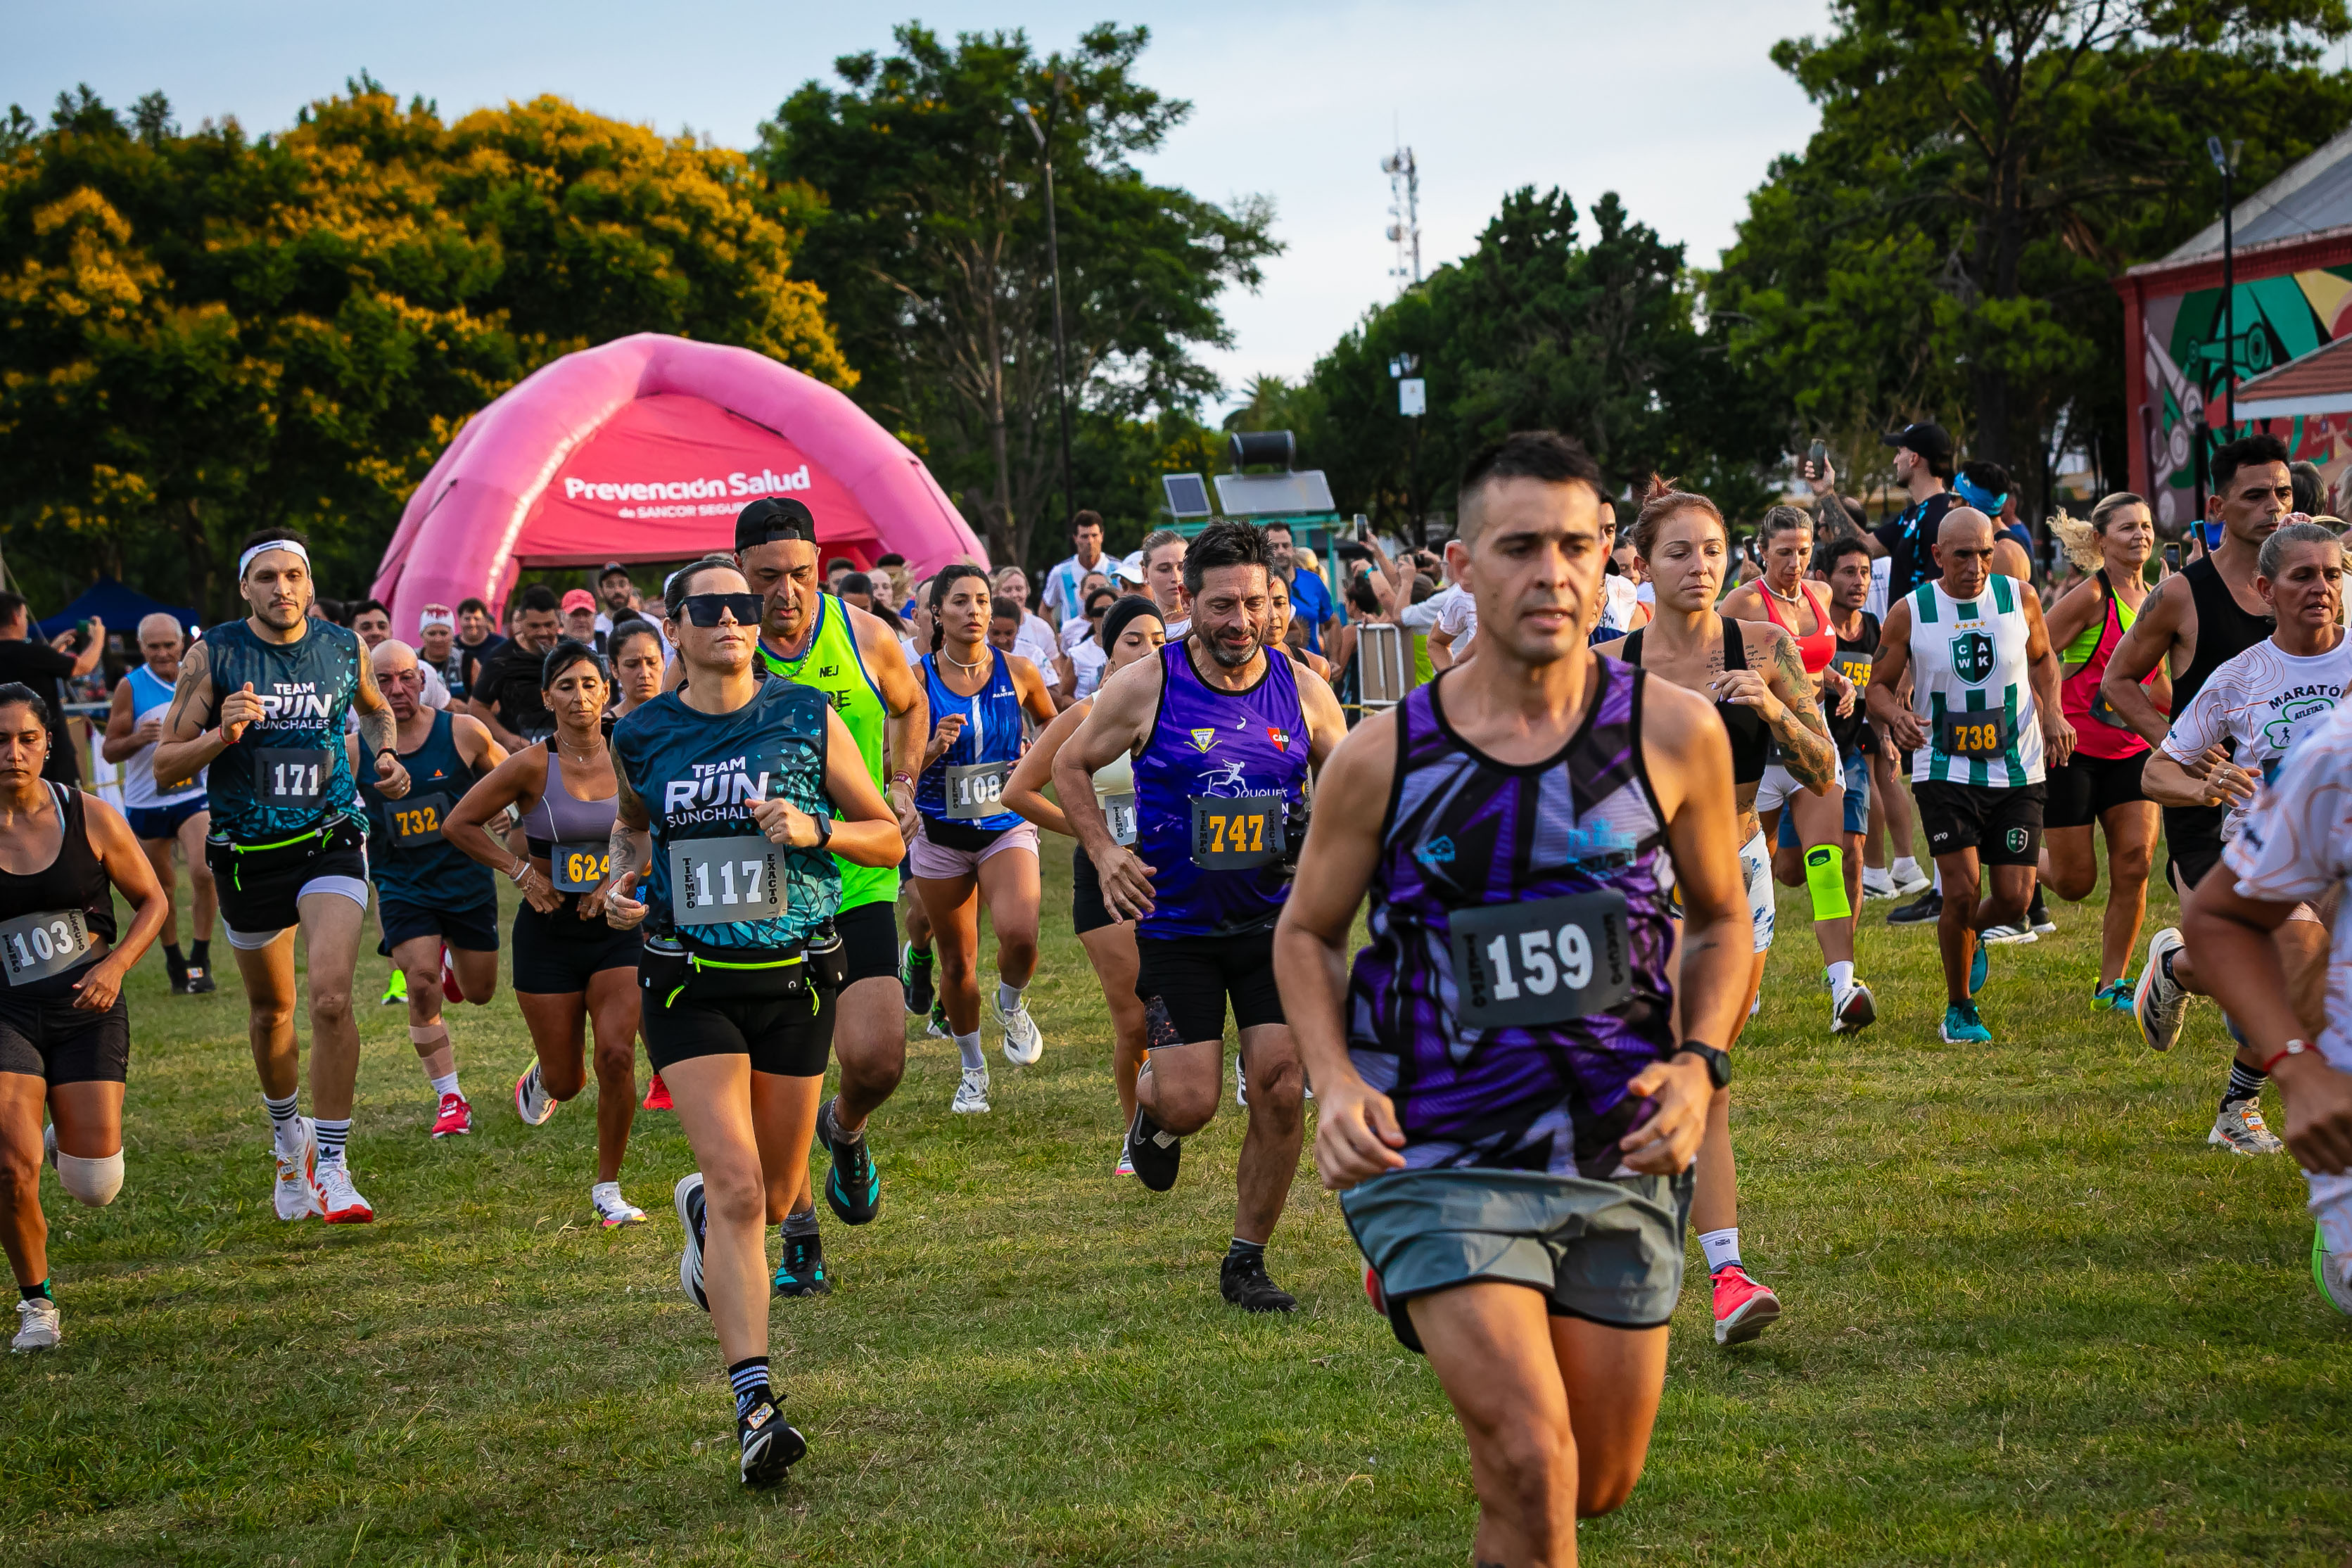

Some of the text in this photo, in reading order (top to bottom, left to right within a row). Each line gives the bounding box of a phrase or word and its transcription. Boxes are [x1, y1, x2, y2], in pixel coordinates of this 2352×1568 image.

[564, 464, 811, 502] Prevención Salud
[637, 505, 697, 519] SANCOR
[273, 682, 316, 695] TEAM
[1843, 662, 1871, 687] 755
[258, 694, 333, 720] RUN
[2294, 703, 2325, 720] ATLETAS
[254, 719, 331, 730] SUNCHALES
[1272, 734, 1290, 743] CAB
[1955, 724, 1997, 751] 738
[274, 763, 319, 796] 171
[692, 756, 746, 779] TEAM
[665, 772, 770, 814] RUN
[960, 775, 1001, 805] 108
[395, 807, 438, 836] 732
[666, 805, 756, 828] SUNCHALE
[1113, 805, 1124, 839] TIEMPO
[1268, 809, 1278, 853] EXACTO
[1198, 810, 1209, 855] TIEMPO
[1209, 815, 1264, 853] 747
[568, 853, 610, 883] 624
[696, 860, 763, 906] 117
[767, 853, 778, 905] EXACTO
[682, 857, 697, 910] TIEMPO
[13, 920, 75, 967] 103
[1487, 923, 1594, 1000] 159
